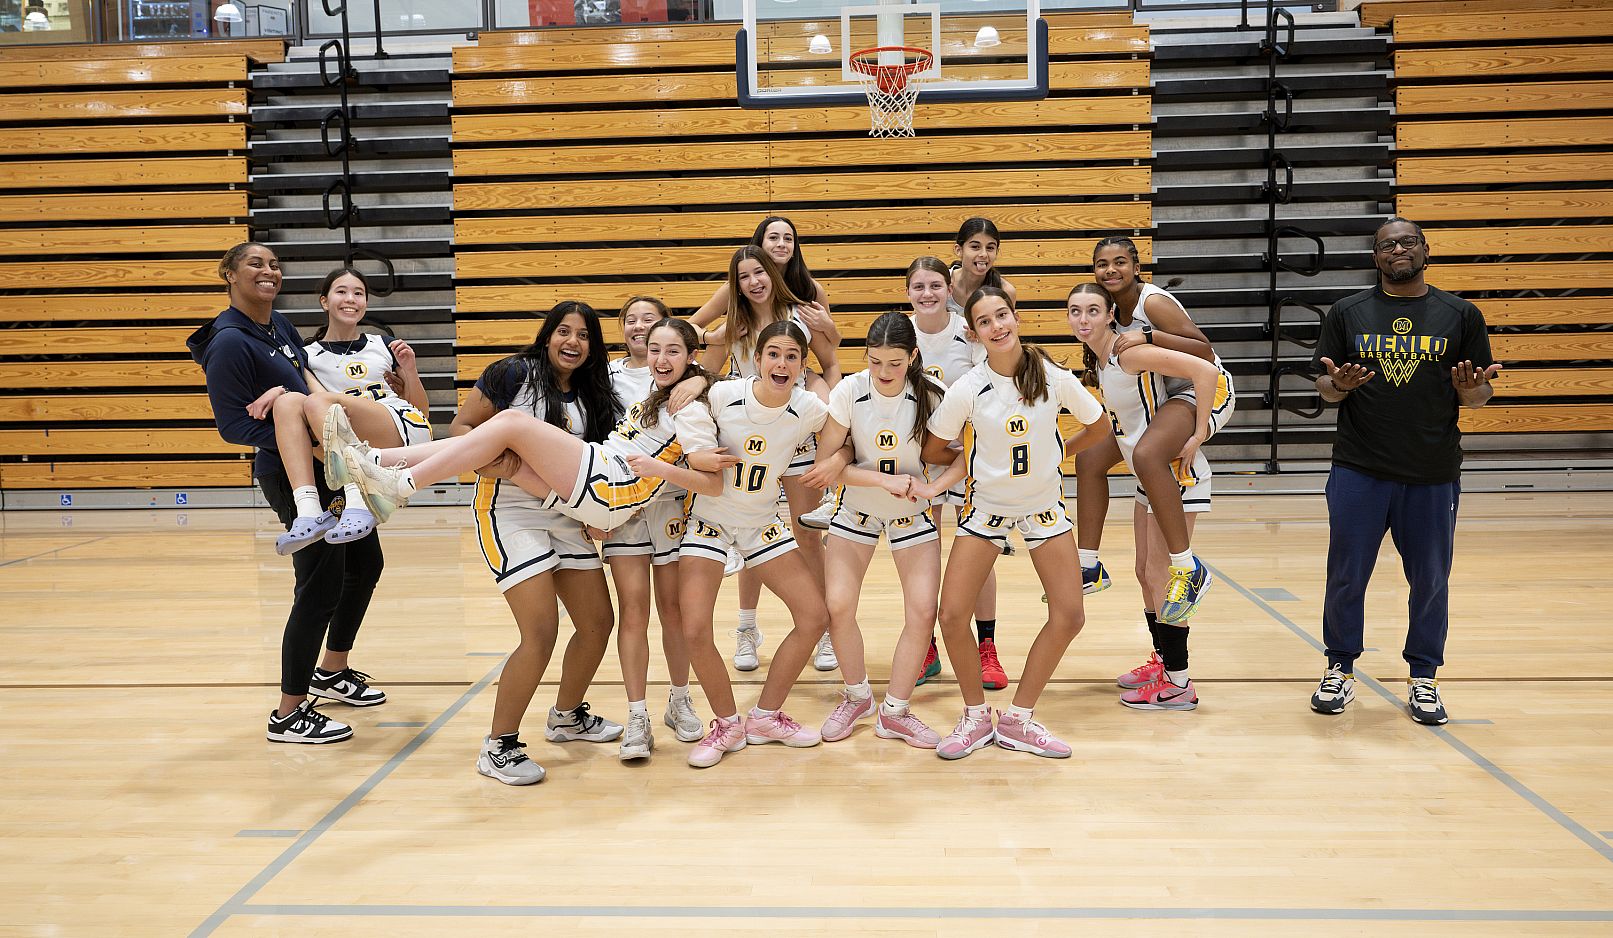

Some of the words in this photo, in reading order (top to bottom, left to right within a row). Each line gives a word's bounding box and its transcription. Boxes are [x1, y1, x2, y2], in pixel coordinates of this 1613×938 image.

[1355, 334, 1448, 355] MENLO
[1360, 352, 1440, 362] BASKETBALL
[348, 364, 364, 376] M
[1009, 419, 1025, 433] M
[748, 440, 763, 452] M
[879, 434, 894, 446] M
[1011, 443, 1030, 477] 8
[733, 460, 769, 493] 10
[857, 511, 870, 526] 7
[1037, 511, 1055, 524] M
[669, 522, 681, 536] M
[763, 526, 779, 541] M
